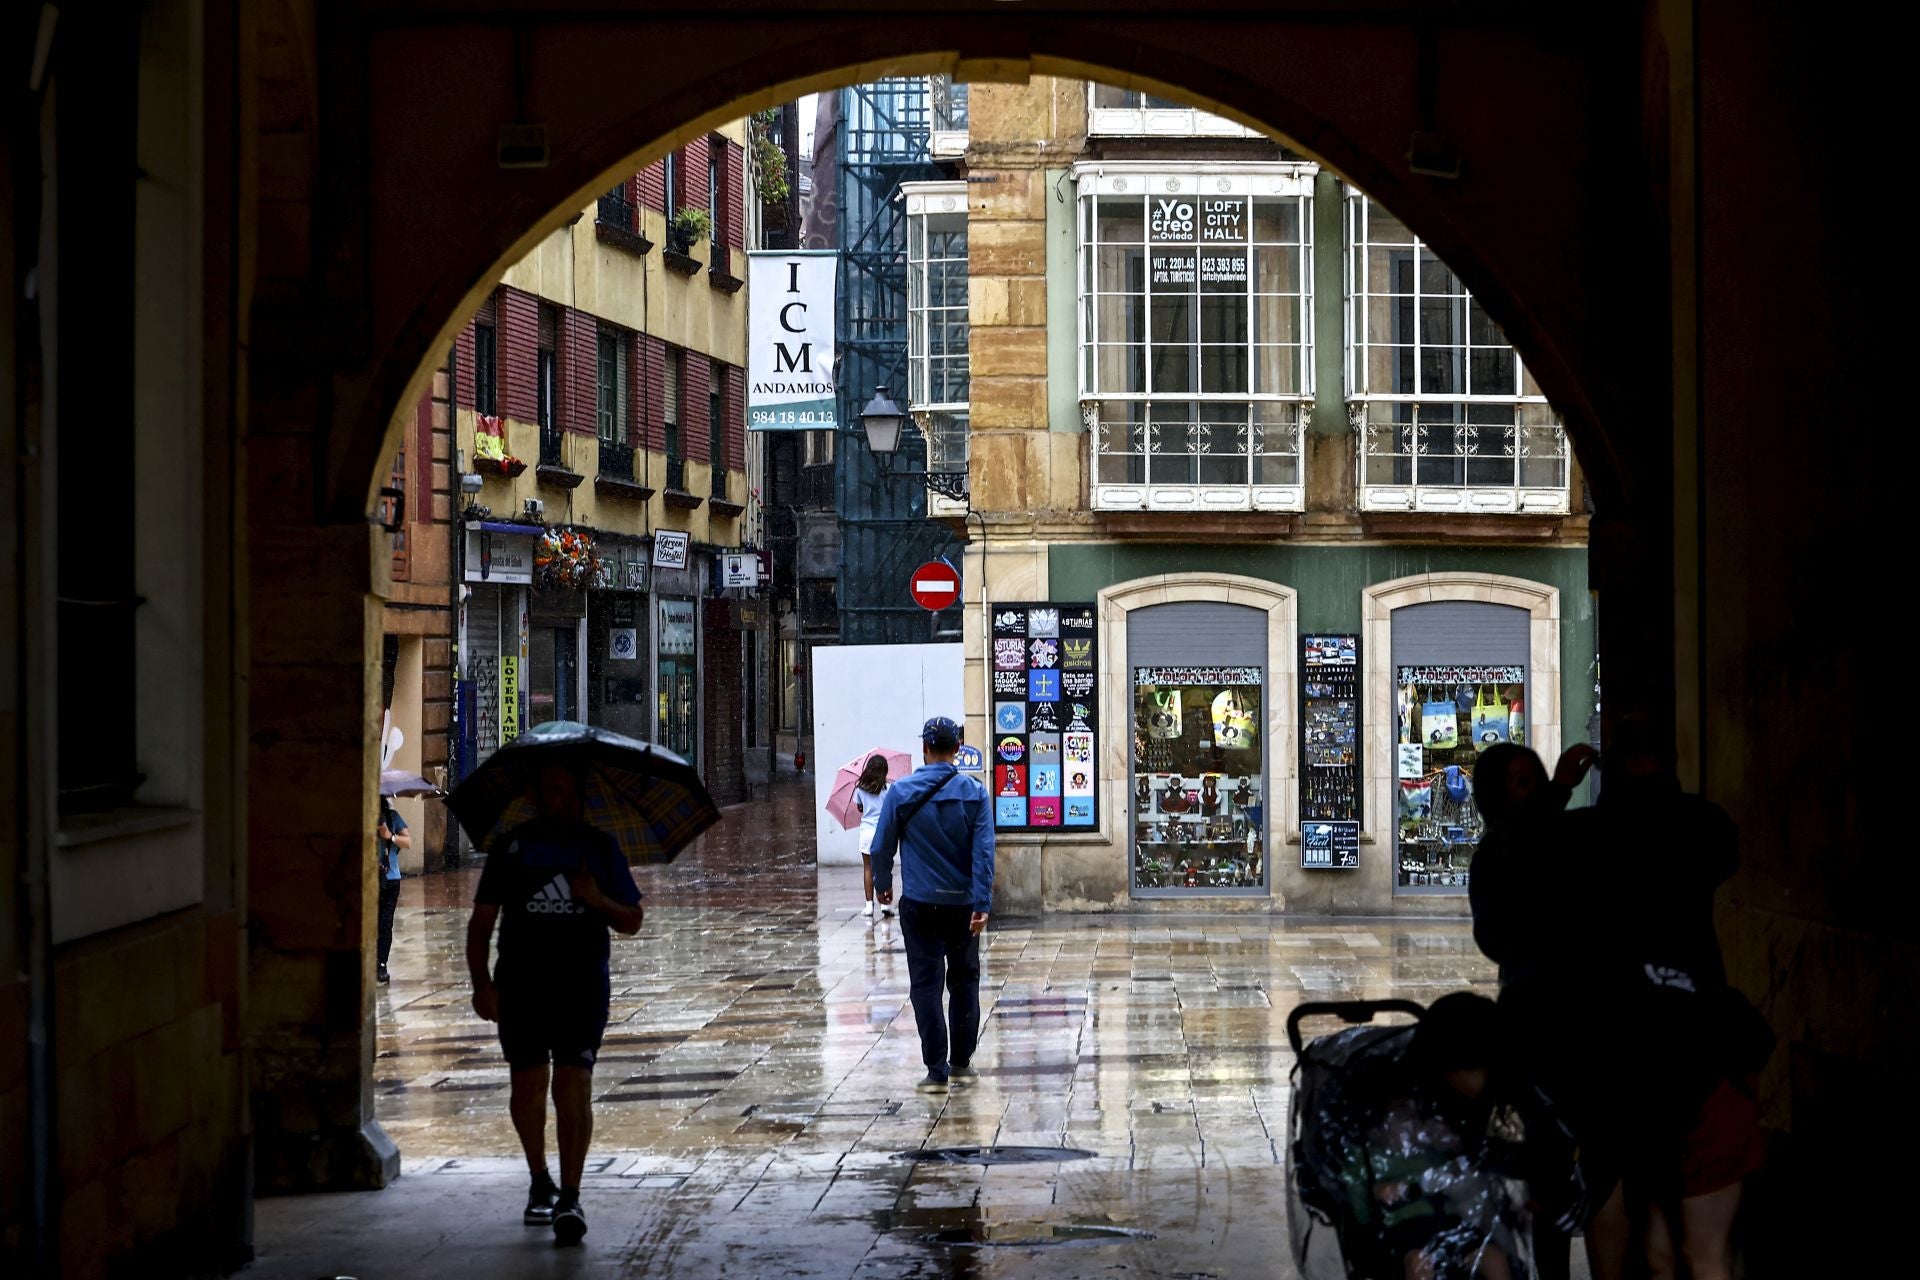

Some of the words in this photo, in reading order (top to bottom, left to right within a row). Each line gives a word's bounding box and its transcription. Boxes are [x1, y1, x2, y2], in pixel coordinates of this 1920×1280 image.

[1152, 199, 1193, 221] #Yo
[1205, 201, 1243, 212] LOFT
[1152, 220, 1193, 232] creo
[1207, 214, 1240, 226] CITY
[1160, 231, 1193, 240] Oviedo
[1204, 228, 1243, 240] HALL
[1153, 257, 1168, 270] VUT.
[1201, 257, 1215, 272] 623
[1231, 257, 1245, 272] 855
[753, 382, 834, 394] ANDAMIOS
[752, 411, 776, 424] 984
[779, 411, 795, 424] 18
[799, 411, 815, 424] 40
[818, 411, 834, 424] 13
[660, 537, 683, 549] Green
[659, 549, 683, 561] Hostel
[1062, 618, 1093, 626] ASTURIAS
[995, 640, 1025, 652] ASTURIAS
[504, 658, 514, 724] LOTERIA
[1069, 738, 1087, 748] OVI
